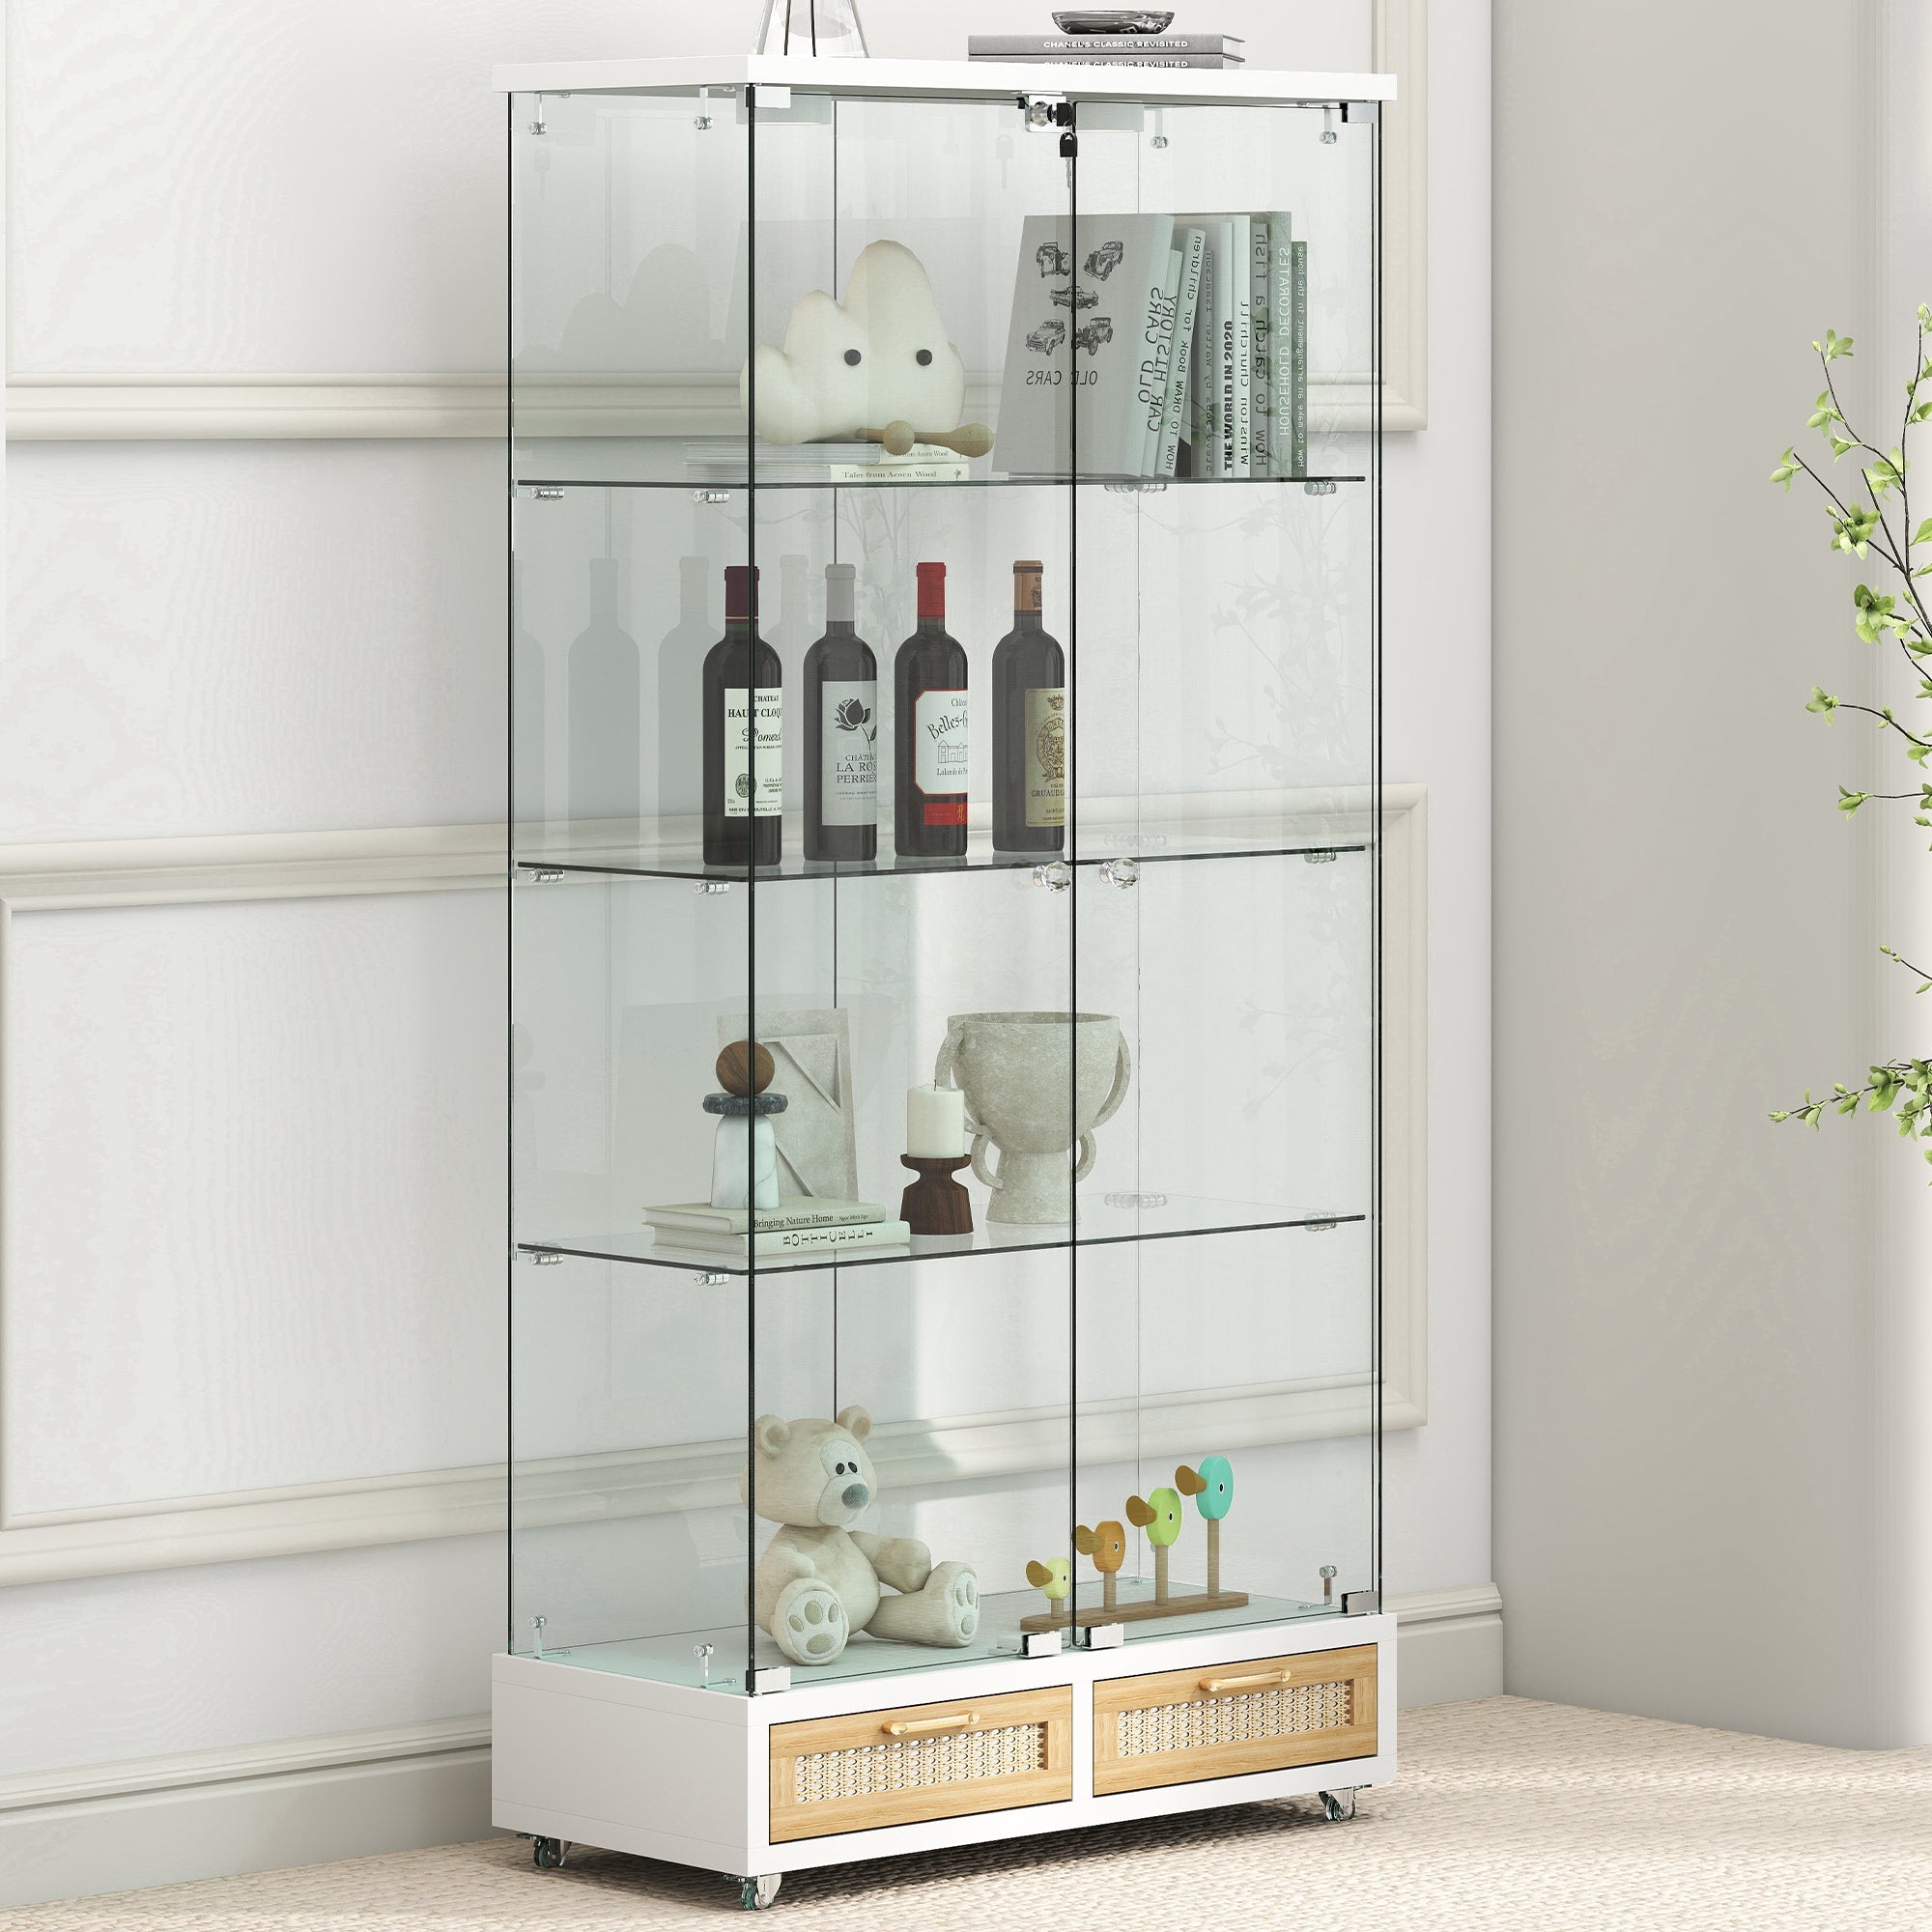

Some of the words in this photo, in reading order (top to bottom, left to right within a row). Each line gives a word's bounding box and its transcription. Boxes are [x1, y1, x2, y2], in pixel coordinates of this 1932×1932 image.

[1224, 321, 1233, 360] 2020
[1224, 363, 1233, 381] IN
[1224, 383, 1233, 441] WORLD
[1224, 442, 1233, 470] THE
[836, 762, 854, 772] LA
[753, 1218, 784, 1229] Bringing
[785, 1216, 810, 1226] Nature
[811, 1214, 834, 1223] Home
